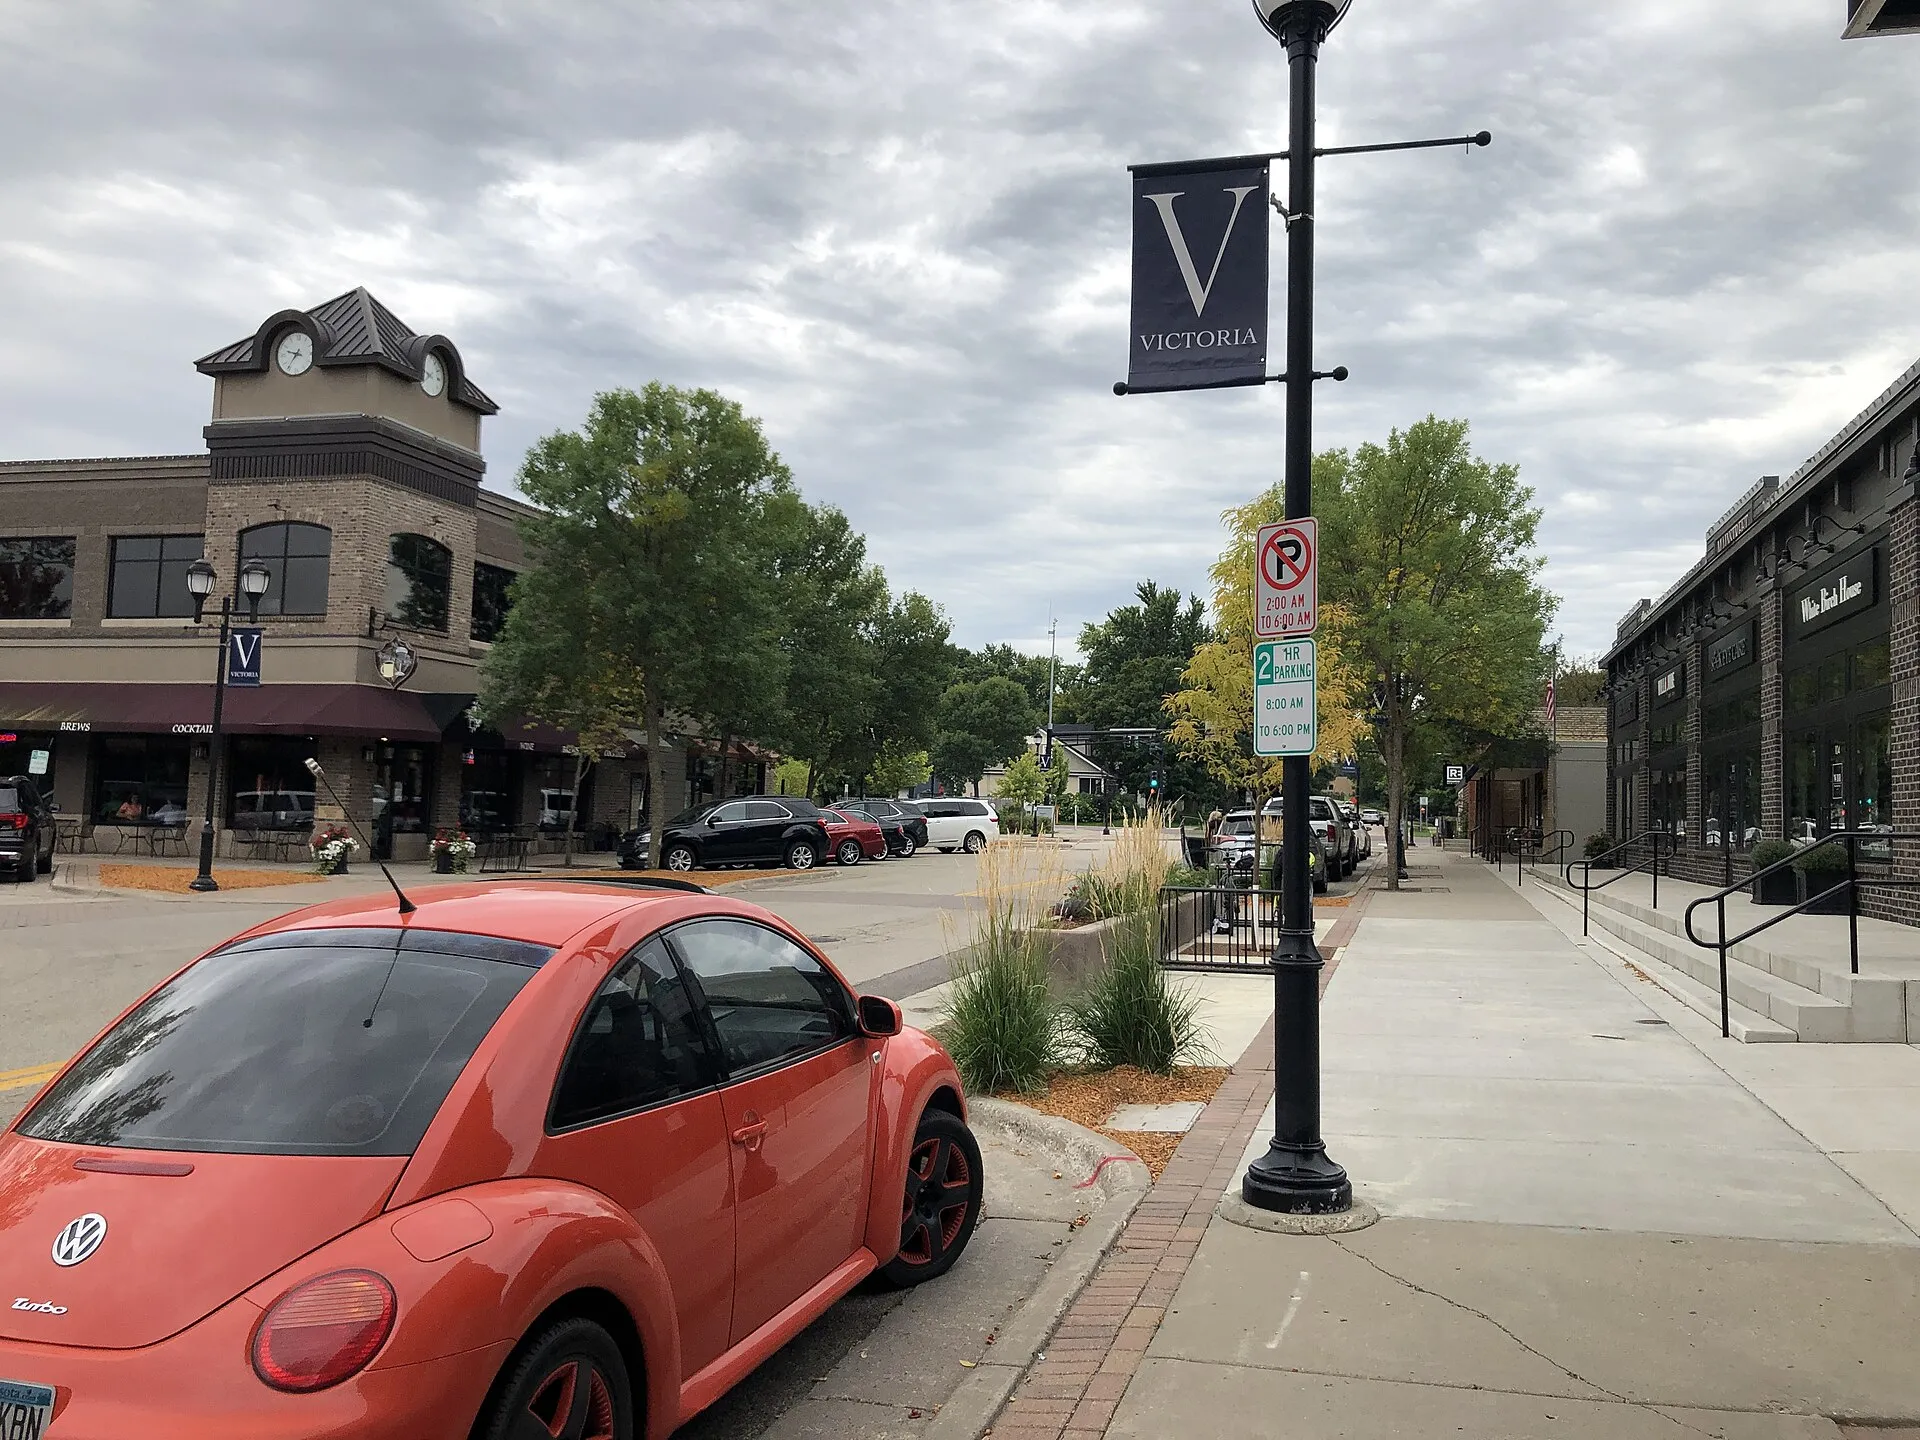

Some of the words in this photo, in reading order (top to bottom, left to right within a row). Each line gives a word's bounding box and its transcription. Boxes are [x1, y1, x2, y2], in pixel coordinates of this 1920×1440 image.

[1142, 185, 1259, 318] V
[1140, 327, 1257, 351] VICTORIA
[1266, 596, 1287, 611] 2:00
[1291, 594, 1305, 609] AM
[1801, 596, 1820, 623] White
[1820, 588, 1838, 613] Birch
[1839, 575, 1862, 603] House
[1261, 616, 1271, 629] TO
[1274, 613, 1294, 628] 6:00
[1297, 611, 1311, 626] AM
[233, 634, 260, 669] V
[1285, 646, 1300, 661] HR
[1258, 651, 1271, 679] 2
[1274, 663, 1311, 679] PARKING
[1266, 697, 1287, 710] 8:00
[1290, 697, 1303, 709] AM
[60, 721, 91, 731] BREWS
[1260, 725, 1270, 736] TO
[1273, 724, 1294, 736] 6:00
[1297, 723, 1310, 735] PM
[1041, 756, 1050, 768] V
[51, 1212, 108, 1267] VW
[11, 1297, 68, 1315] Turbo
